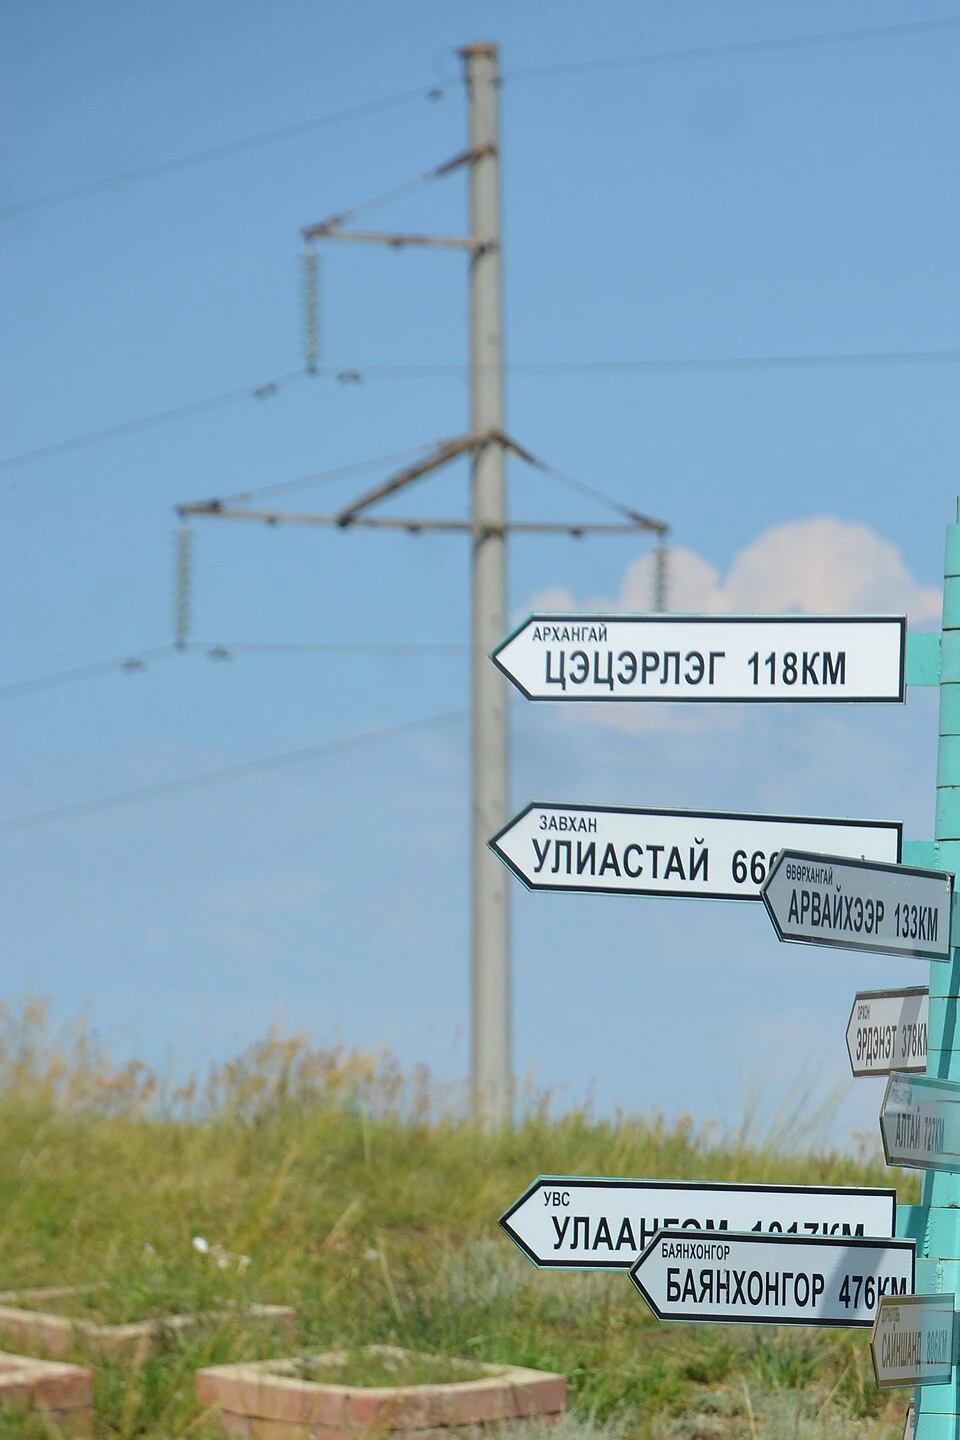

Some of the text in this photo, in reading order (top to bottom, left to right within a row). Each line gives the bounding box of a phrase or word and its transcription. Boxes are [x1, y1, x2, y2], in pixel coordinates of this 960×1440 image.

[532, 623, 608, 642] АРХАНГАЙ
[545, 650, 847, 690] ЦЭЦЭРЛЭГ 118КМ
[539, 815, 598, 833] ЗАВХАН
[532, 837, 709, 882] УЛИАСТАЙ
[788, 885, 938, 942] АРВАЙХЭЭР 133КМ
[857, 1025, 897, 1066] ЭРДЭНЭТ
[543, 1192, 571, 1208] УВС
[661, 1242, 730, 1261] БАЯНХОНГОР
[666, 1268, 825, 1308] БАЯНХОНГОР
